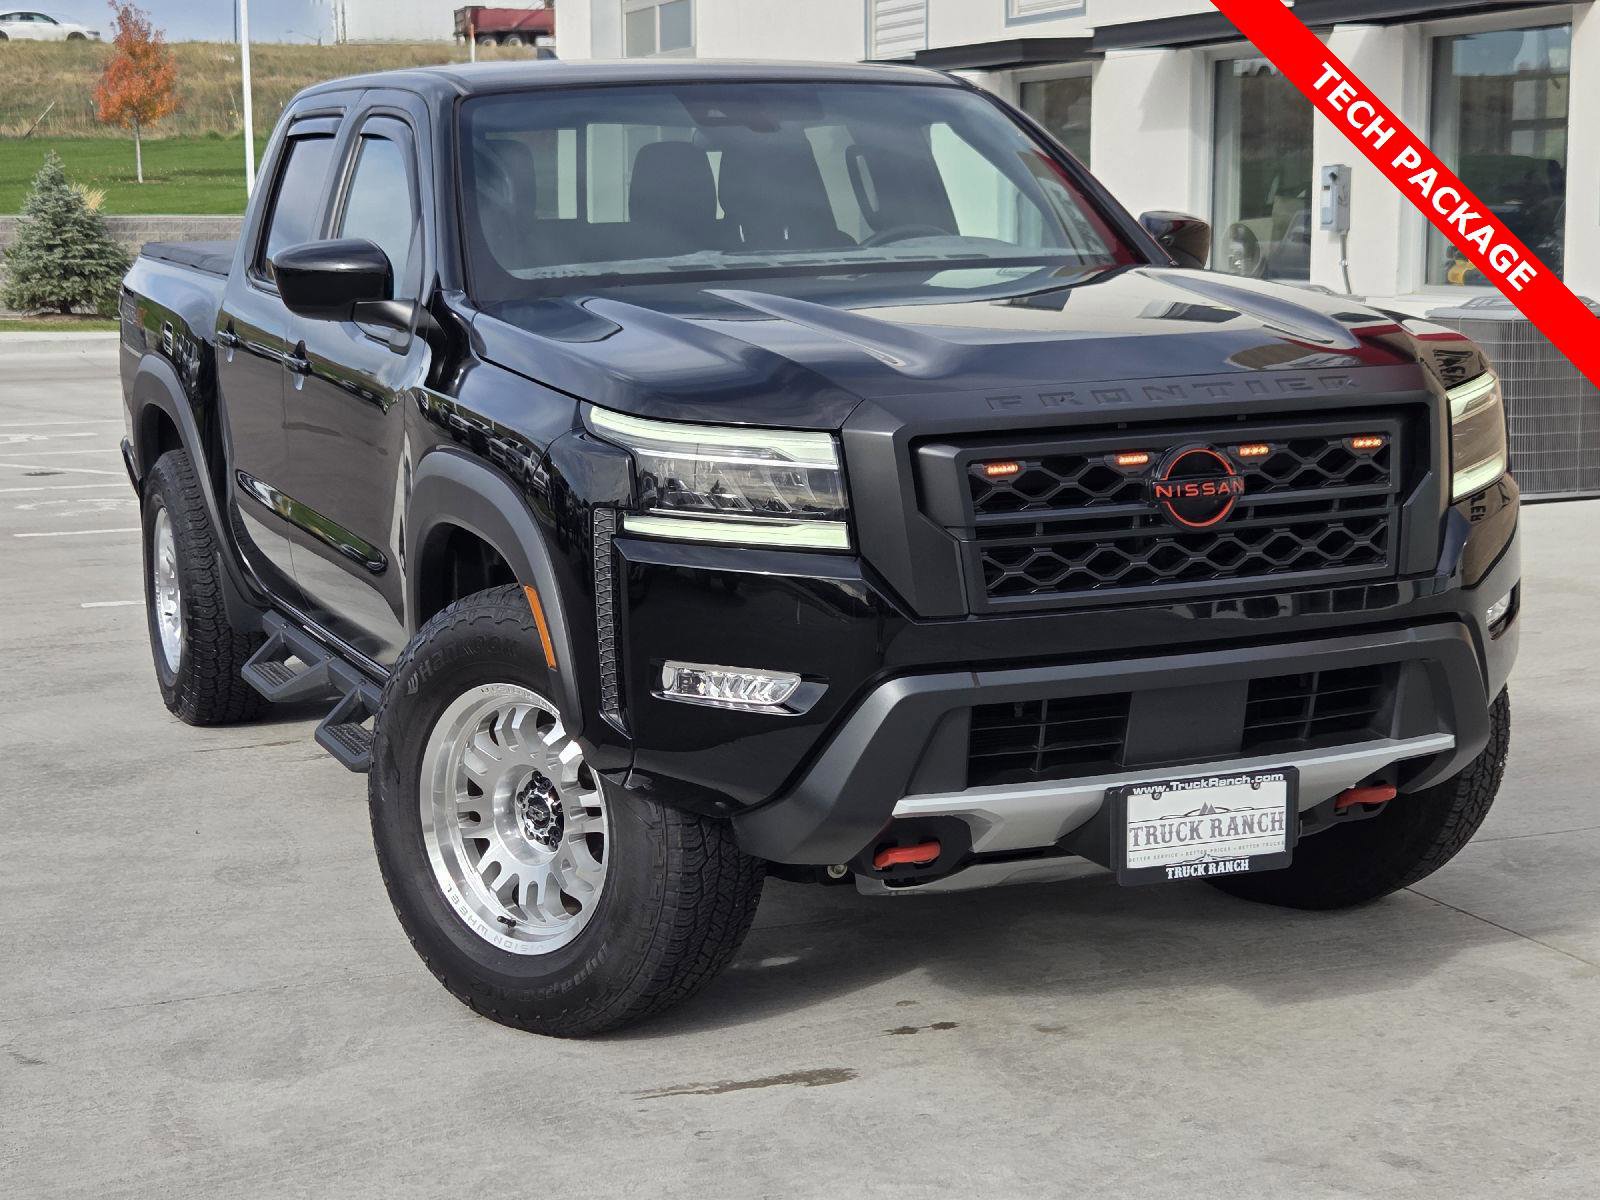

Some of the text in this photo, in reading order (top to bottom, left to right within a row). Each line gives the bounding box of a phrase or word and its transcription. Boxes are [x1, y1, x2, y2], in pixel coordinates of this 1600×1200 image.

[985, 374, 1358, 411] FRONTIER
[1154, 476, 1246, 499] NISSAN
[1132, 772, 1284, 796] www.TruckRanch.com
[1129, 811, 1285, 847] TRUCK RANCH
[1166, 858, 1250, 880] TRUCK RANCH
